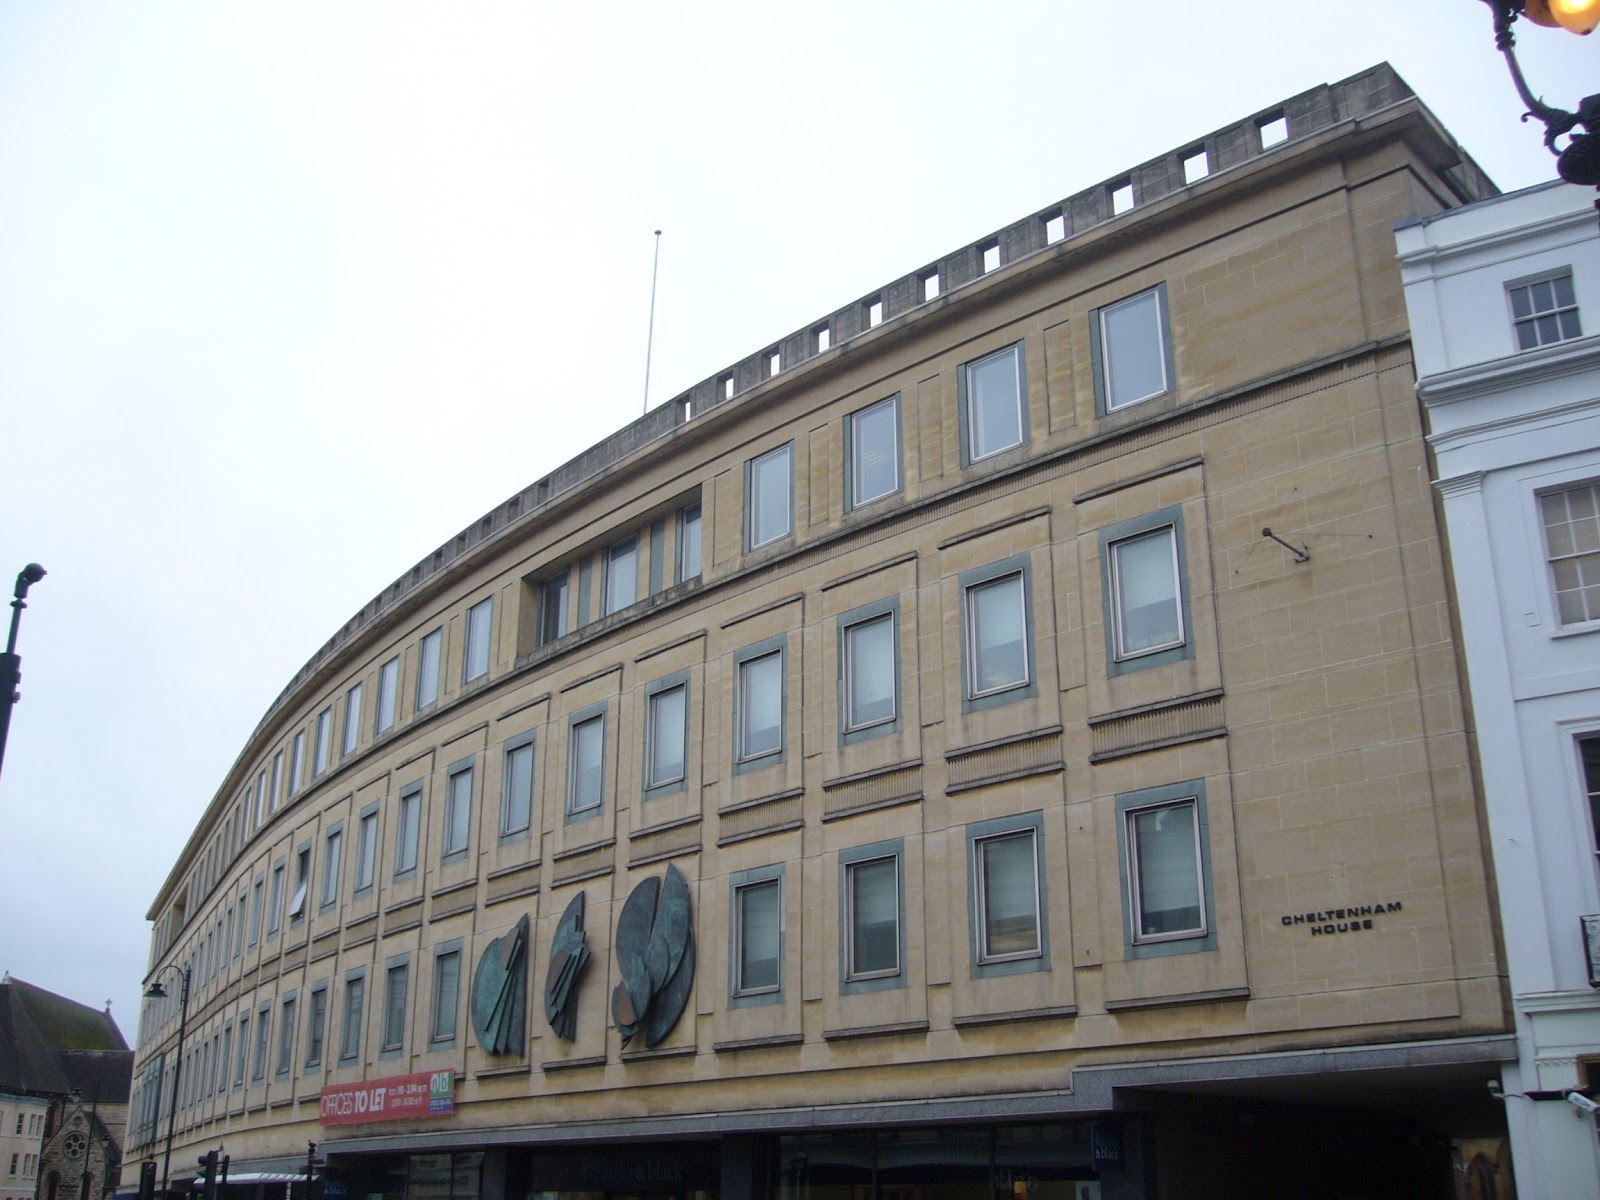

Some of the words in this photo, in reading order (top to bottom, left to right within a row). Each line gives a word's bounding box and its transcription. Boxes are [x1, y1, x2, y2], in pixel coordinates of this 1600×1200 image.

[1281, 901, 1403, 926] CHELTENHAM
[1311, 919, 1373, 936] HOUSE
[320, 1092, 352, 1117] OFFICES
[354, 1090, 368, 1113] TO
[369, 1088, 387, 1112] LET
